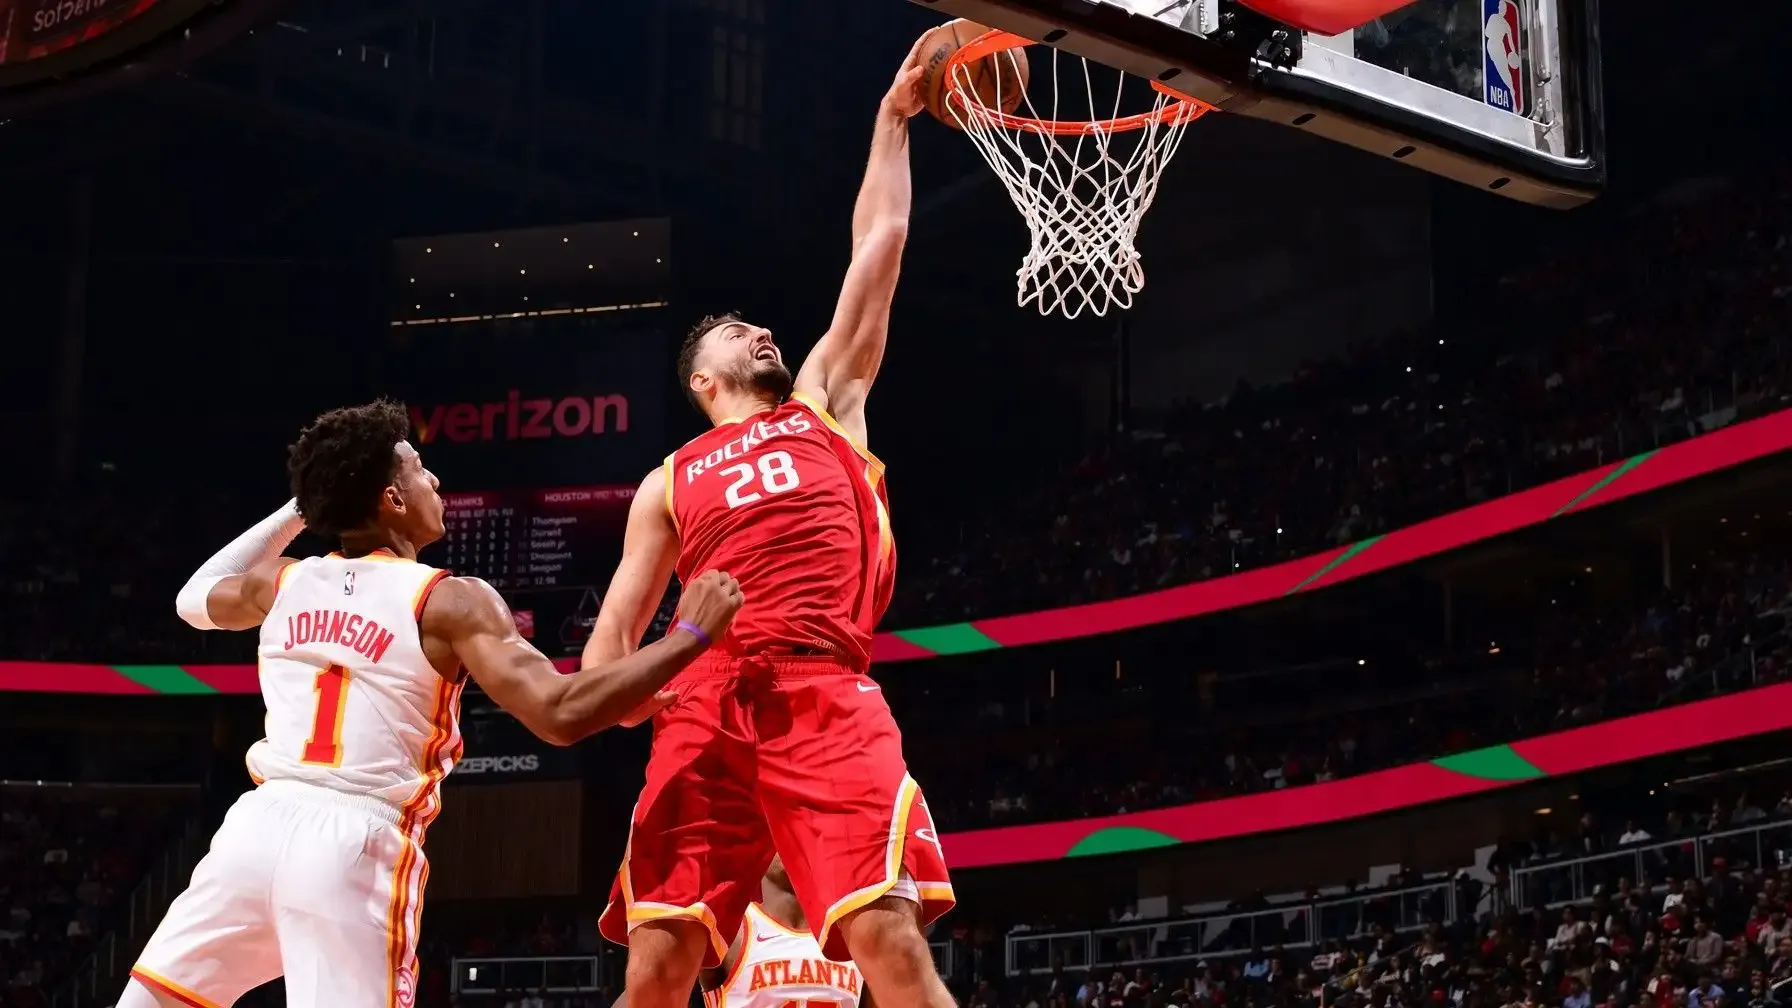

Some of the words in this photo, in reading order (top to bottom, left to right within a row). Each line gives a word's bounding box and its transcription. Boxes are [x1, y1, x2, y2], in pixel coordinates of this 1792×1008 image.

[1490, 85, 1509, 108] NBA
[409, 388, 629, 444] verizon
[686, 411, 812, 485] ROCKETS
[545, 492, 590, 502] HOUSTON
[718, 450, 801, 509] 28
[284, 610, 395, 665] JOHNSON
[300, 662, 352, 768] 1
[453, 754, 540, 774] ZEPICKS
[749, 959, 858, 996] ATLANTA
